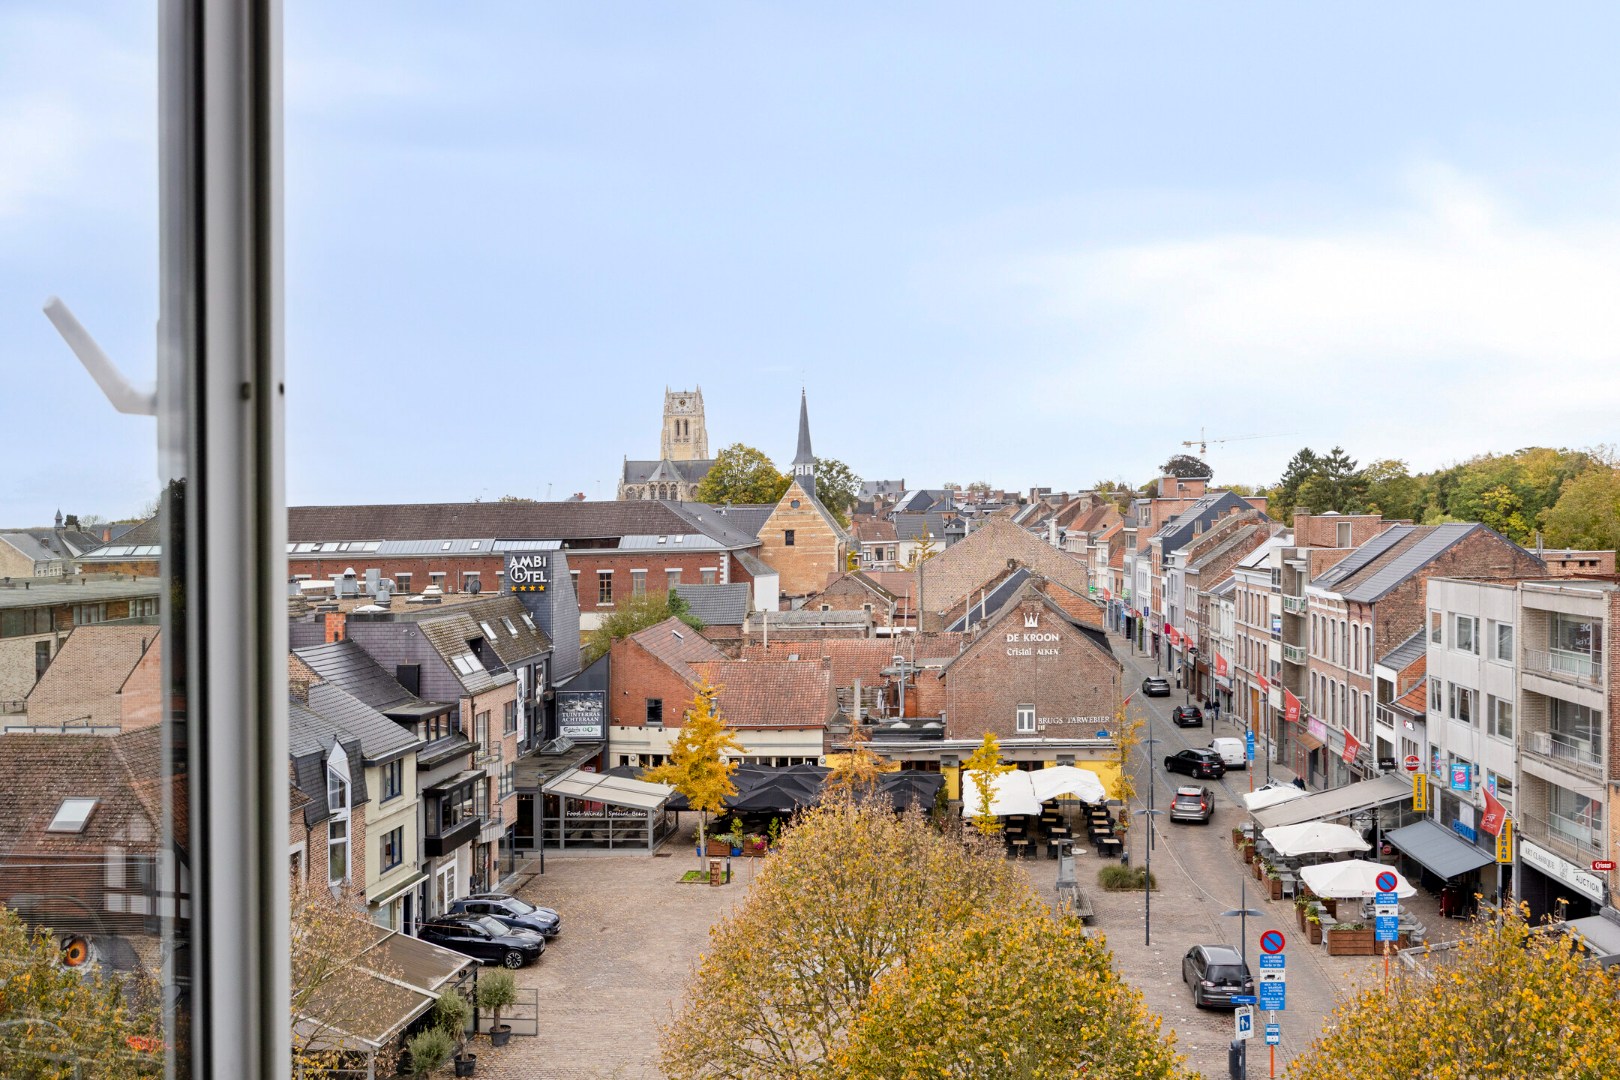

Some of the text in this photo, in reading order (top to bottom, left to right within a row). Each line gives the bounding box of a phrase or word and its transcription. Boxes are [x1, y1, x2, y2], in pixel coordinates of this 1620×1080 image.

[509, 555, 547, 568] AMBI
[1006, 633, 1060, 643] DE KROON
[1006, 647, 1032, 656] Cristal
[1037, 715, 1110, 725] BRUGS TARWEBIER
[1595, 861, 1612, 869] Cristal
[1576, 875, 1600, 893] AUCTION
